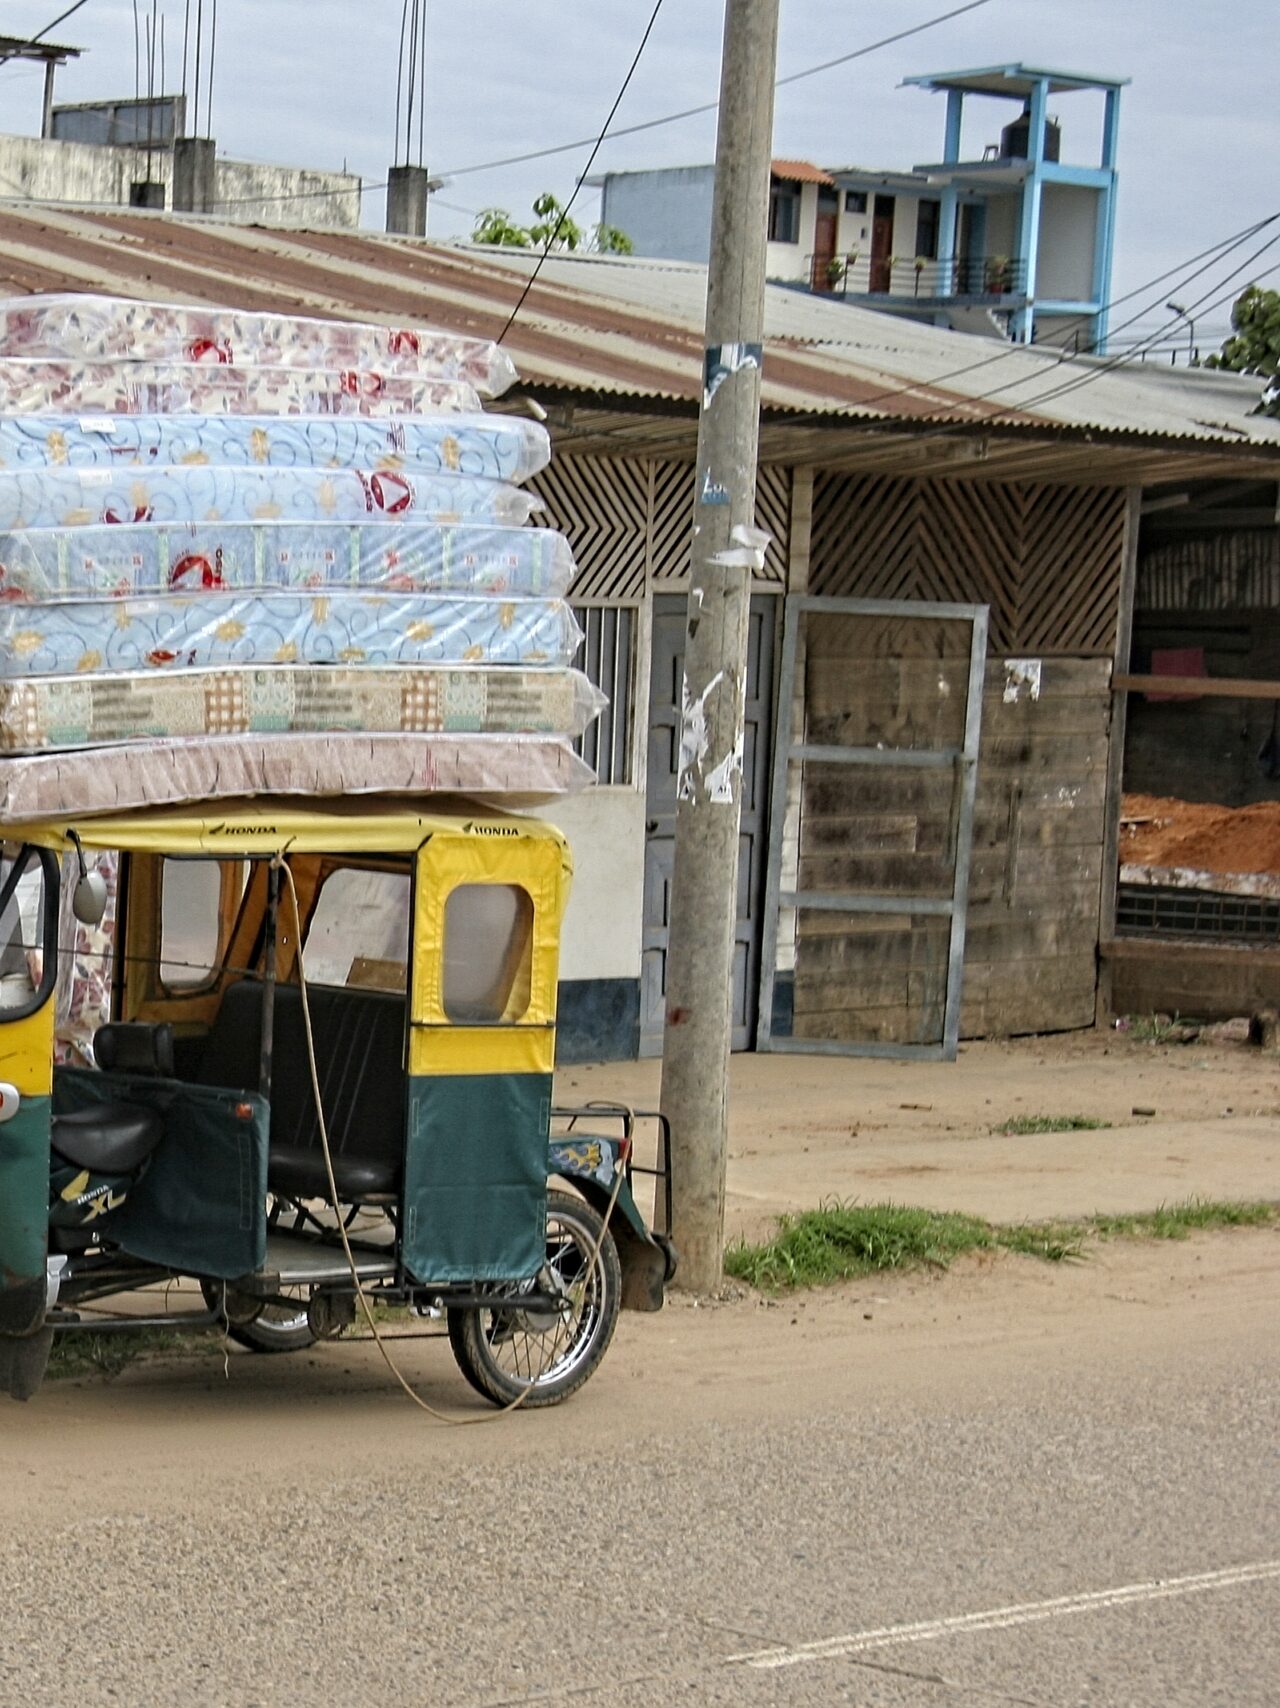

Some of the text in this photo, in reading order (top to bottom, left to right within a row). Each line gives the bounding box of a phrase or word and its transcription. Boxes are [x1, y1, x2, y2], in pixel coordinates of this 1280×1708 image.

[225, 825, 277, 835] HONDA
[474, 826, 519, 836] HONDA
[76, 1184, 110, 1205] HONDA
[80, 1189, 127, 1224] XL
